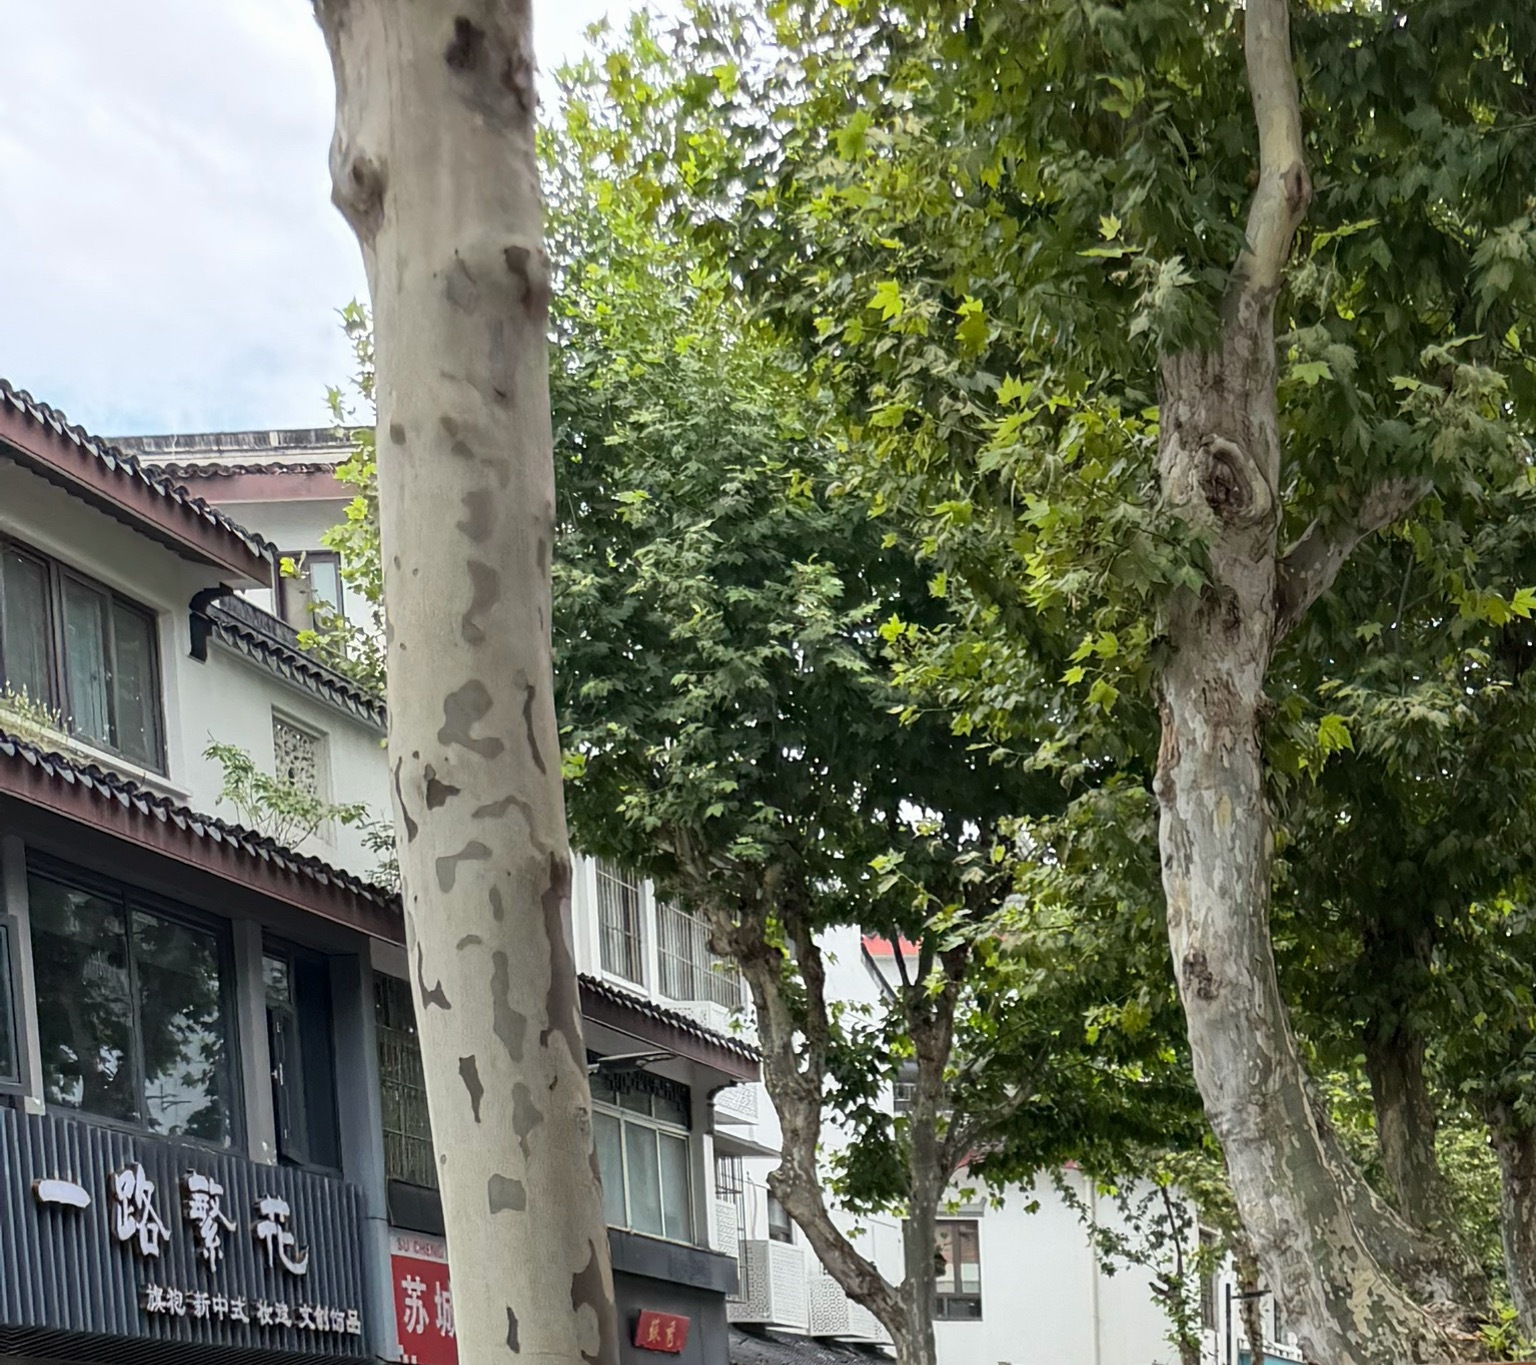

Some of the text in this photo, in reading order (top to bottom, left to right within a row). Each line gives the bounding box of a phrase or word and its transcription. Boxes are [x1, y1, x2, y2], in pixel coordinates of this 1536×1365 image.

[36, 1162, 308, 1275] 一路繁花
[193, 1290, 250, 1324] 新中式
[299, 1303, 361, 1335] 文创饰品
